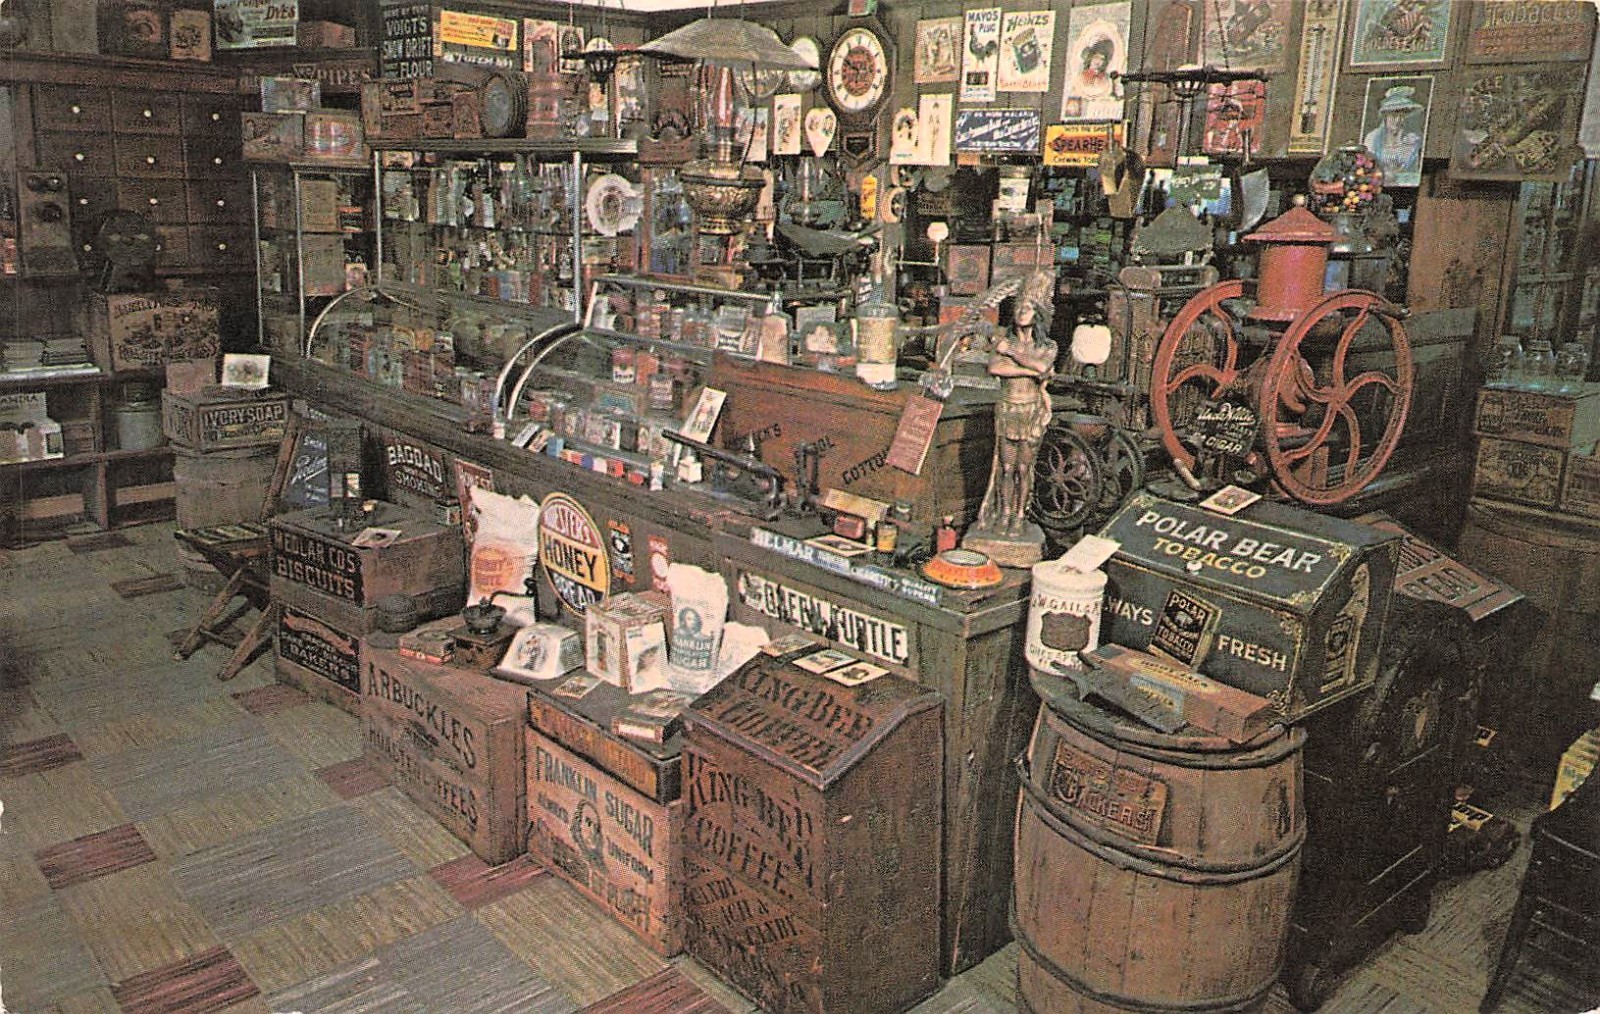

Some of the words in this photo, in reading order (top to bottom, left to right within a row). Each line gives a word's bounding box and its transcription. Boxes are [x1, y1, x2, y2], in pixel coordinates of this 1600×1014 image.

[401, 61, 433, 79] FLOUR
[248, 405, 284, 422] SOAP
[387, 445, 443, 483] BAGDAD
[1205, 436, 1243, 454] CIGAR
[542, 532, 597, 582] HONEY
[1136, 510, 1229, 551] POLAR
[1230, 536, 1322, 574] BEAR
[1154, 537, 1267, 580] TOBACCO
[277, 555, 355, 600] BISCUITS
[1169, 593, 1206, 625] POLAR
[1158, 625, 1194, 654] TOBACCO
[1218, 634, 1287, 672] FRESH
[536, 746, 597, 801] FRANKLIN
[605, 790, 654, 858] SUGAR
[686, 750, 749, 819] KING
